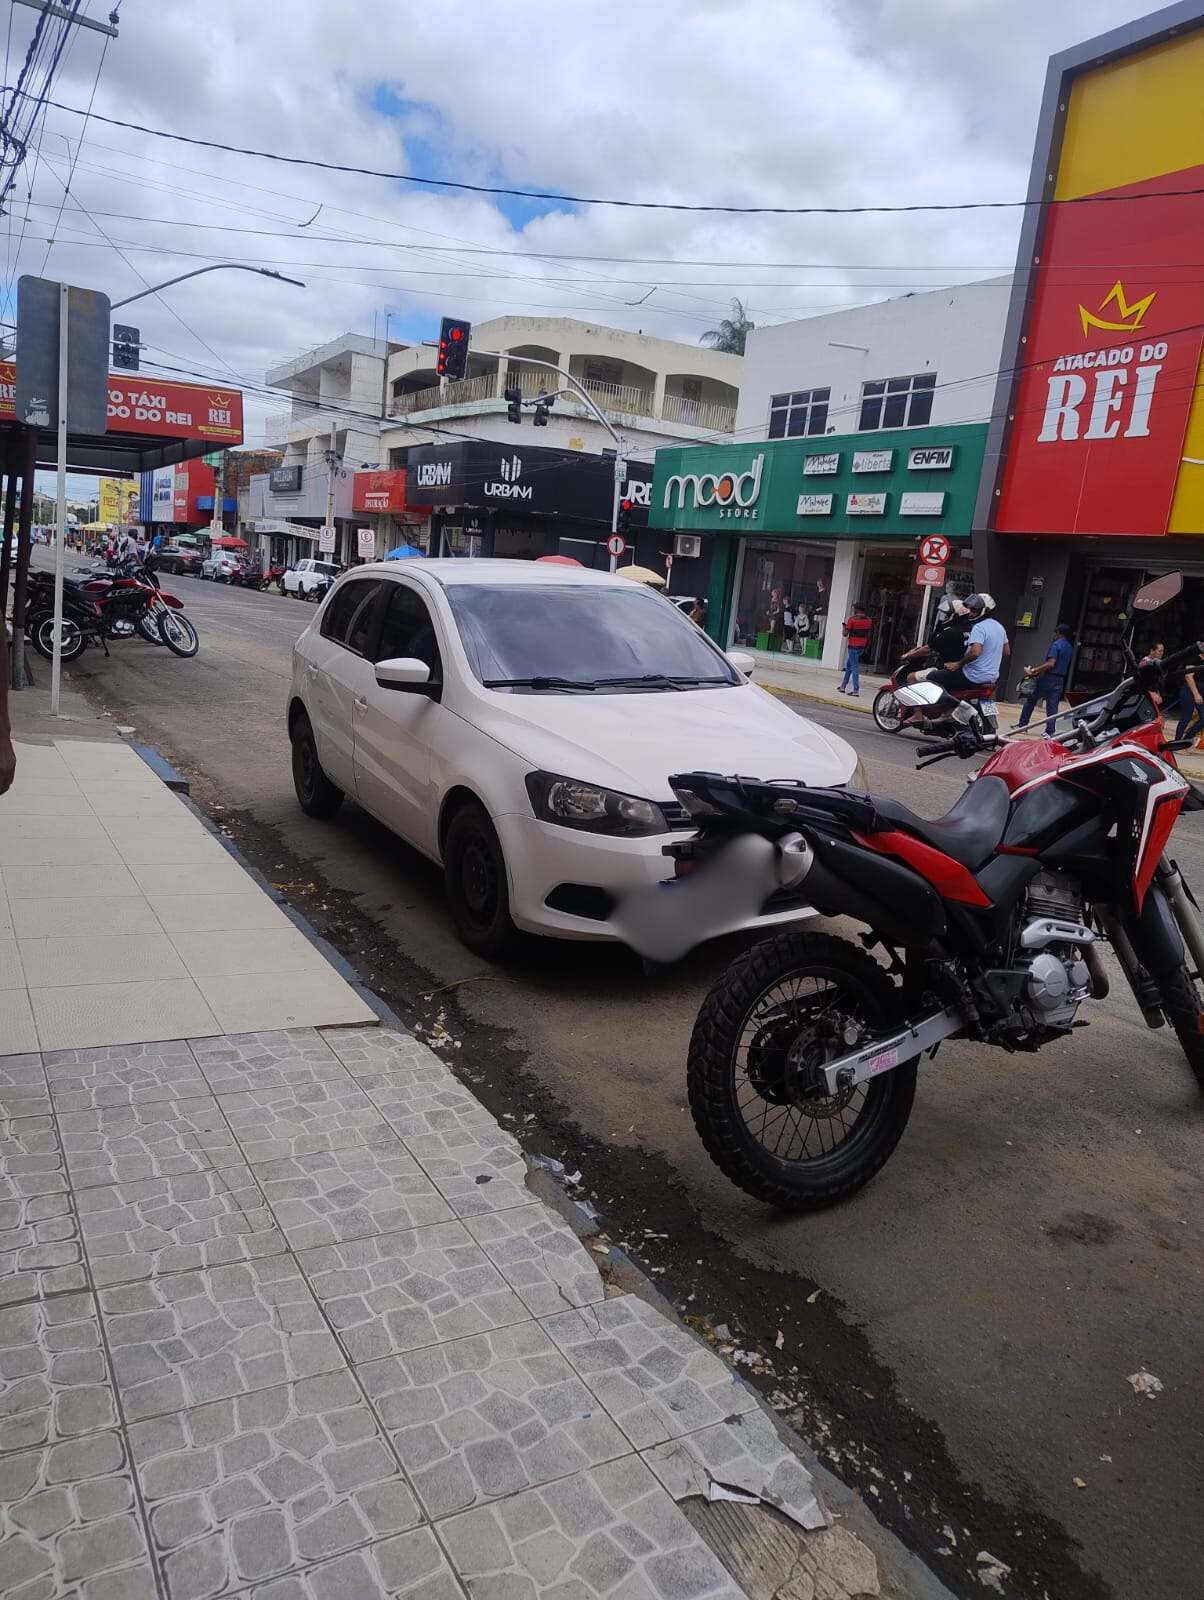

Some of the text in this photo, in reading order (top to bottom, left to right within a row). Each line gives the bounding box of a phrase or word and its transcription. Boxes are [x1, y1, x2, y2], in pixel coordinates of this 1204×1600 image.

[1053, 342, 1168, 372] ATACADO DO
[128, 391, 166, 409] TÁXI
[1037, 364, 1162, 442] REI
[135, 407, 161, 422] DO
[165, 411, 192, 426] REI
[208, 408, 231, 424] REI
[913, 450, 951, 465] ENFIM
[663, 453, 764, 508] mood
[719, 508, 759, 519] STORE
